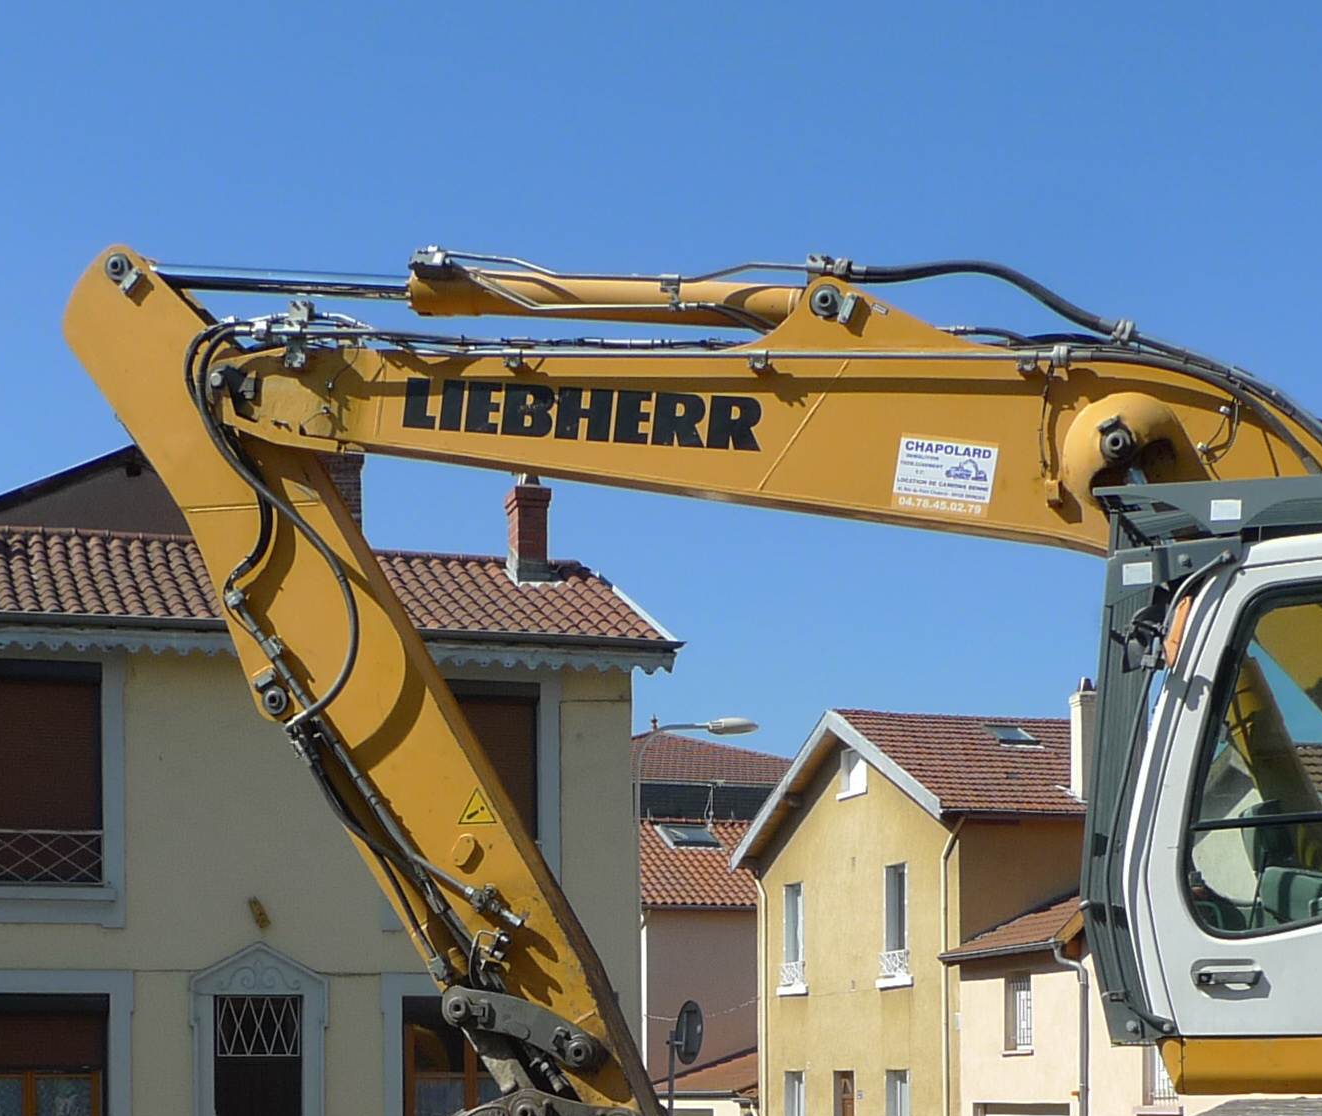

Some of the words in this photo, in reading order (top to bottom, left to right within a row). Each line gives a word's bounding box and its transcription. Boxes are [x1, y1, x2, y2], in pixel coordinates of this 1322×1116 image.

[402, 376, 761, 452] LIEBHERR
[905, 440, 992, 459] CHAPOLARD
[898, 496, 982, 514] 04.78.45.02.79
